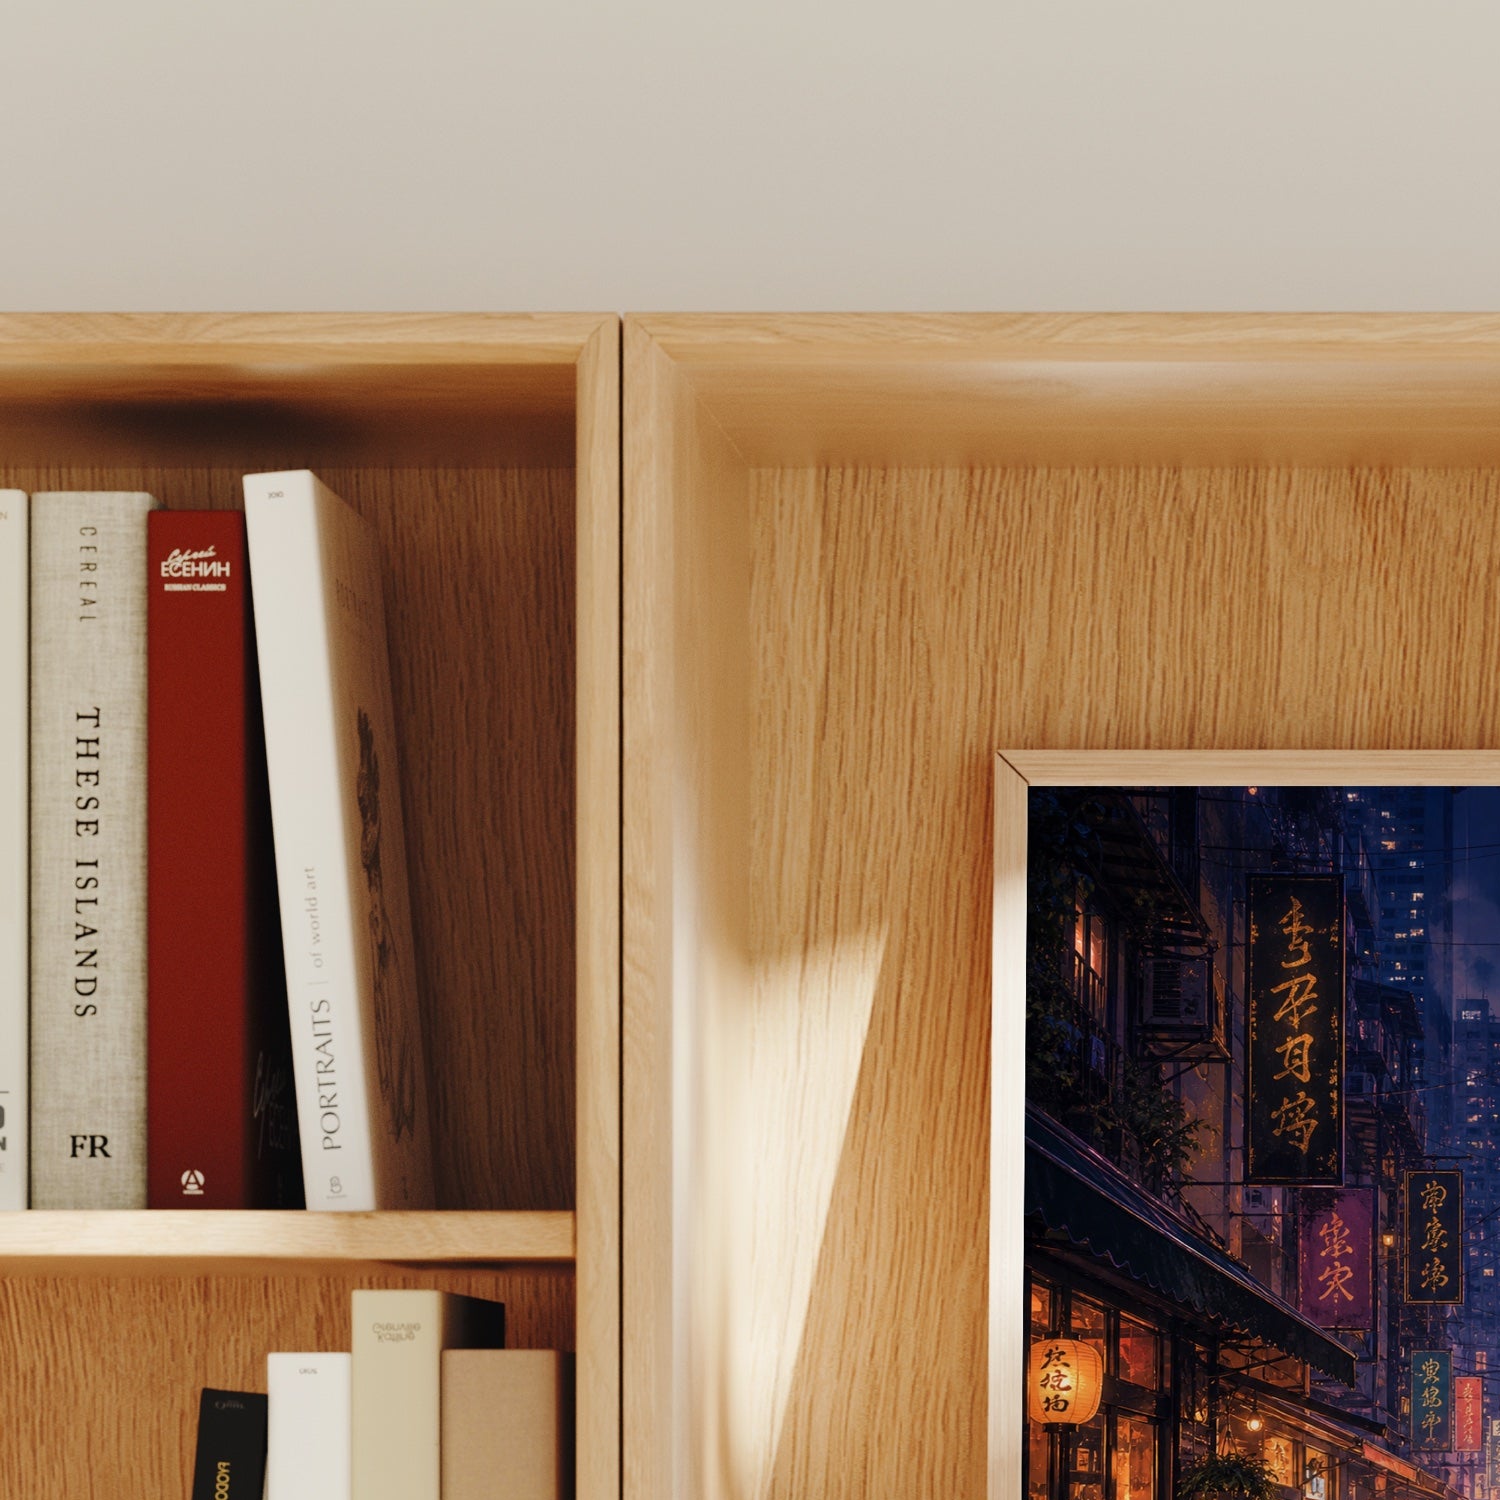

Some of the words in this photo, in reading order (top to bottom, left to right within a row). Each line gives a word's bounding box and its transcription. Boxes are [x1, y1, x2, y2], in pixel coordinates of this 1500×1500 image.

[79, 526, 97, 623] CEREAL
[160, 560, 231, 578] ЕСЕНИН
[75, 707, 101, 837] THESE
[303, 866, 316, 889] art
[74, 859, 99, 1017] ISLANDS
[306, 896, 321, 944] world
[313, 947, 324, 969] of
[310, 999, 343, 1151] PORTRAITS
[69, 1134, 112, 1159] FR
